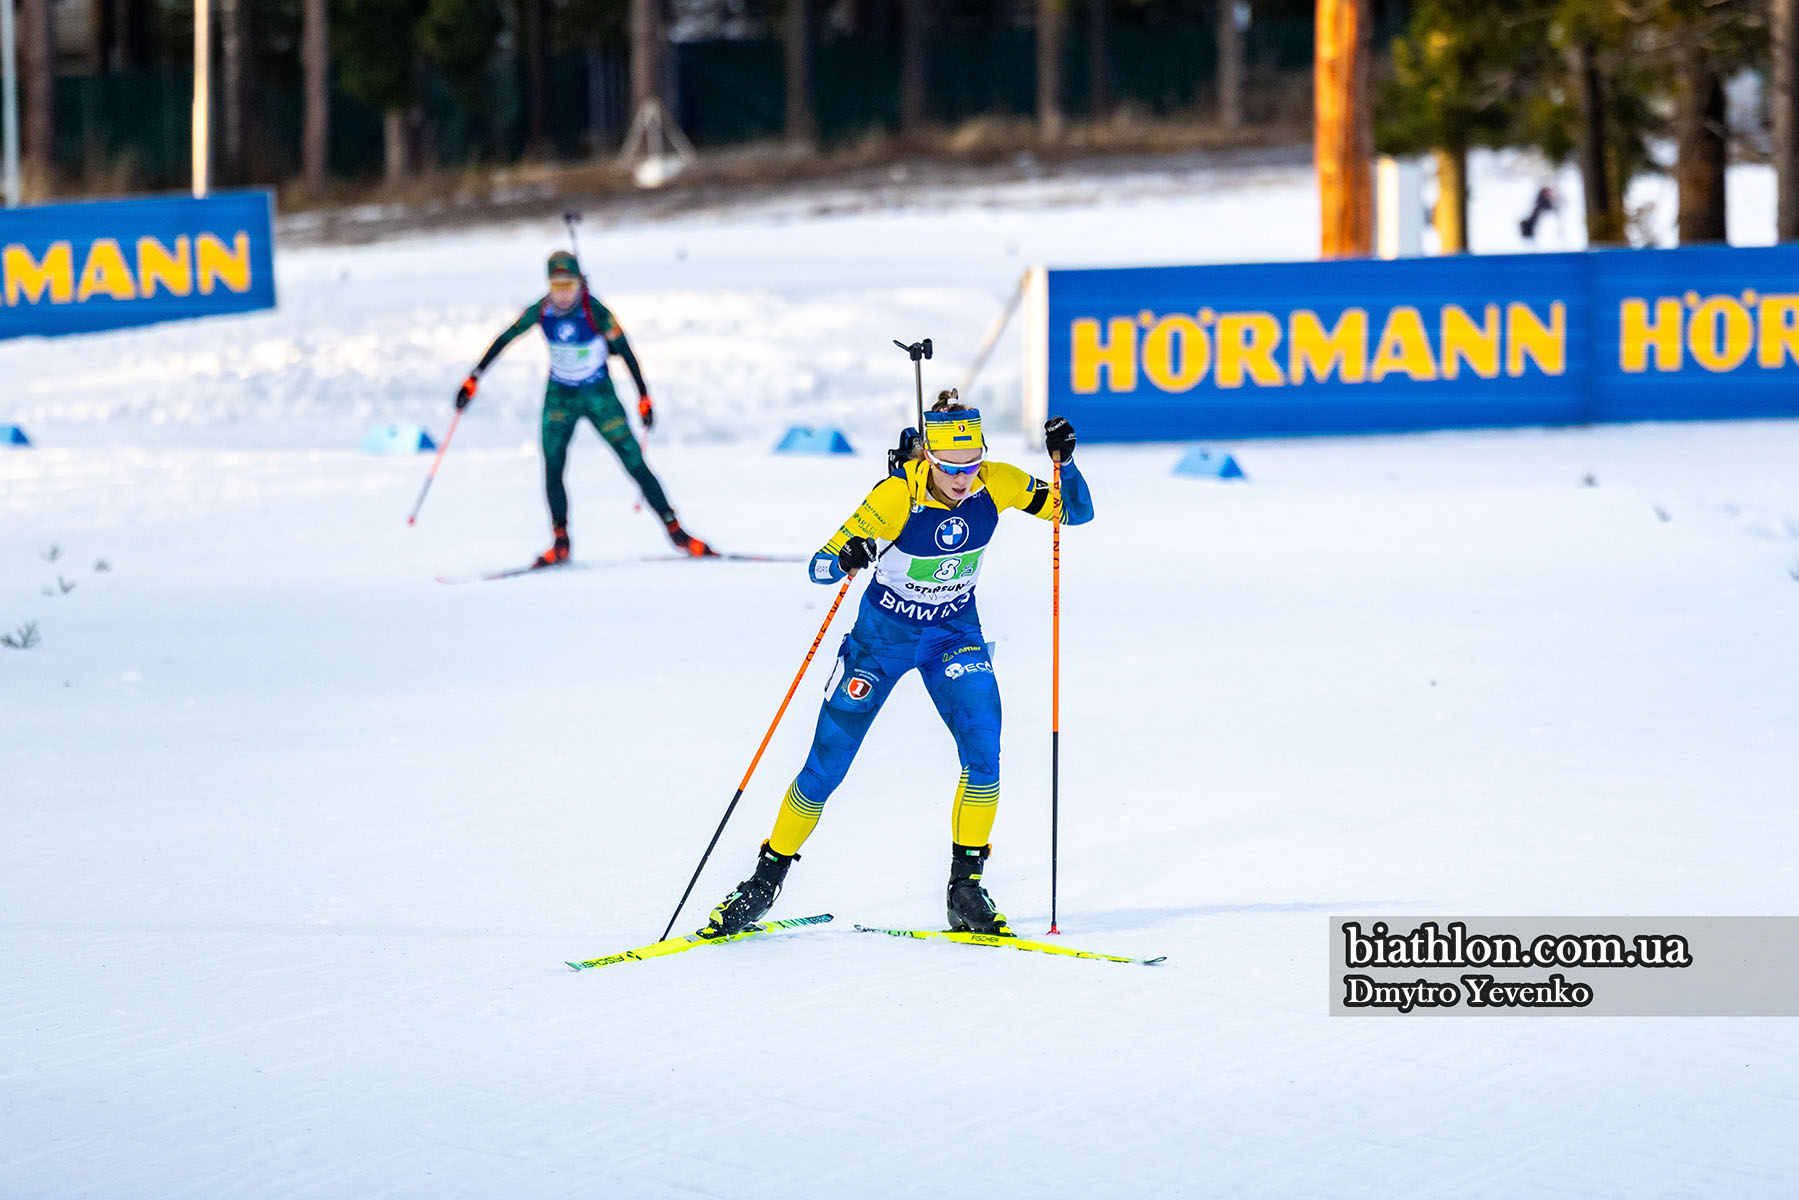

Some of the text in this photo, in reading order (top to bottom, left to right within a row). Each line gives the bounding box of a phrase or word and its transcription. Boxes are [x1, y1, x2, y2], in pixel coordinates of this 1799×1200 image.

[0, 230, 251, 307] MANN
[1070, 300, 1566, 395] HÖRMANN
[933, 558, 962, 582] 8
[879, 590, 939, 621] BMW
[970, 934, 1000, 944] FISCHER
